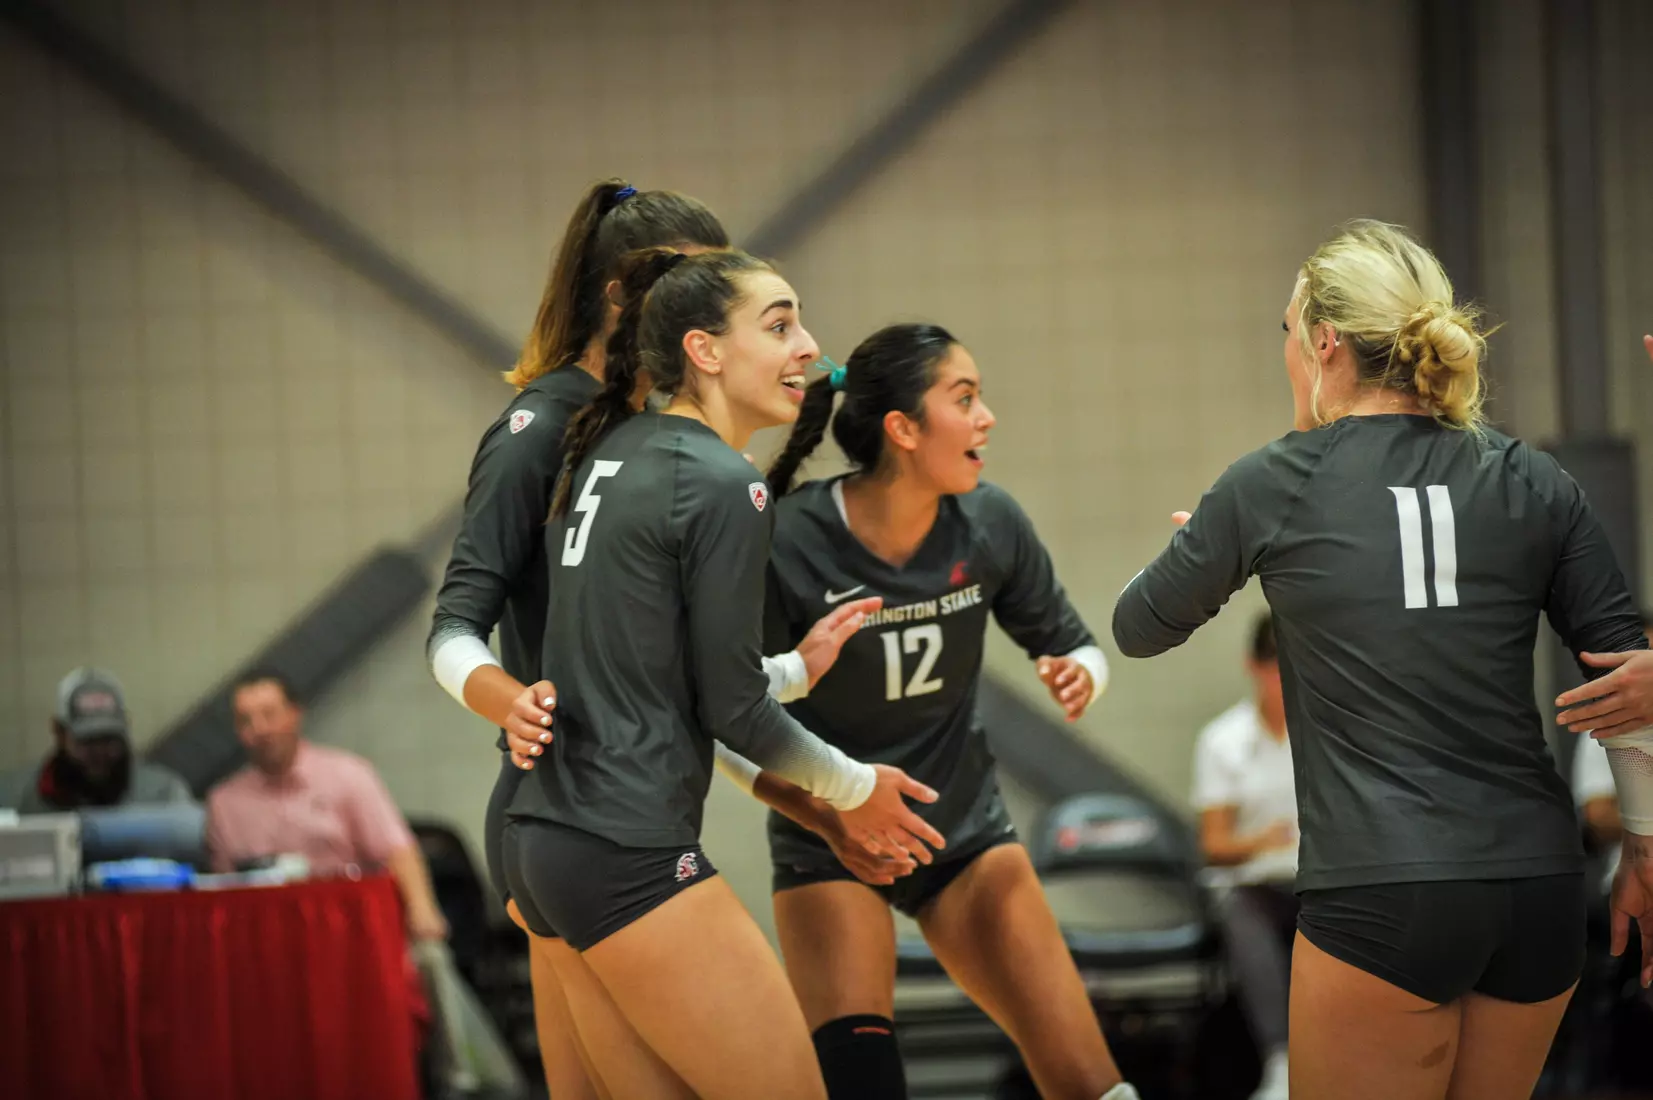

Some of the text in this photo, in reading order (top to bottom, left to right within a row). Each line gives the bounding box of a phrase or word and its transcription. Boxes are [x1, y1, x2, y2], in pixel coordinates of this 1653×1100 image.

[561, 459, 624, 566] 5
[1386, 484, 1459, 609] 11
[861, 584, 982, 628] HINGTON STATE
[879, 623, 943, 701] 12
